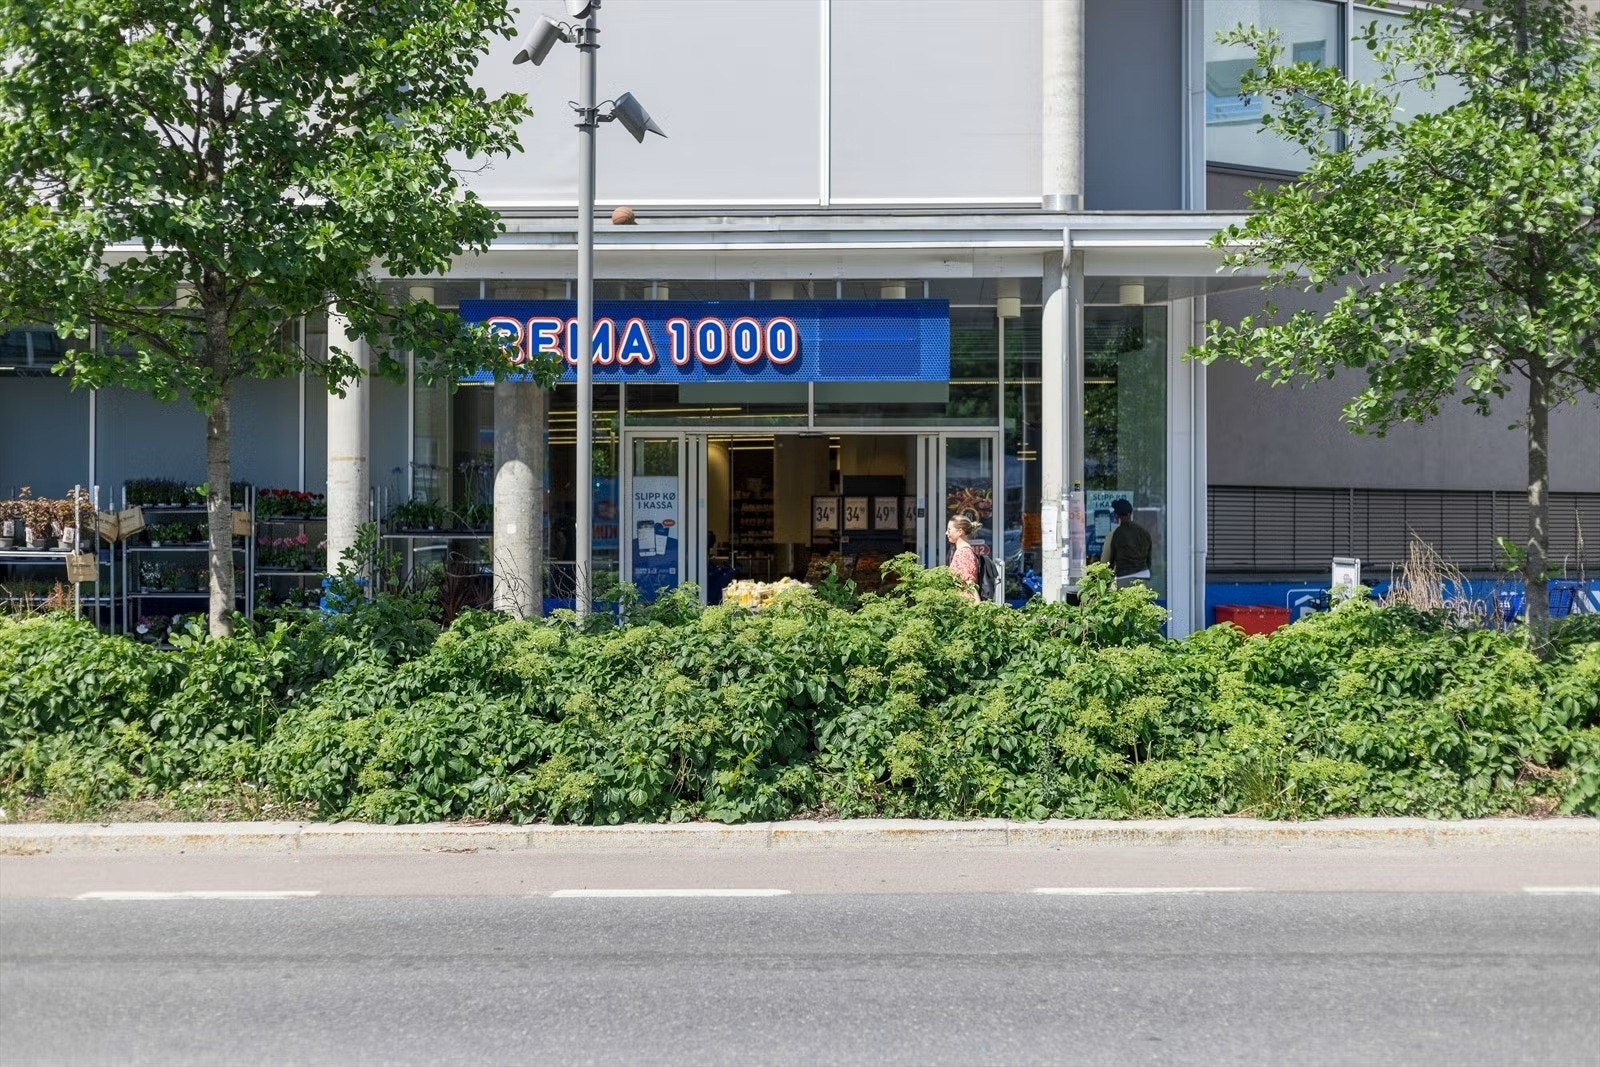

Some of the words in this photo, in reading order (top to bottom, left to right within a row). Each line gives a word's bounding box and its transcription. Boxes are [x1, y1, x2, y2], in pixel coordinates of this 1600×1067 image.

[667, 316, 798, 365] 1000
[635, 492, 660, 501] SLIPP
[662, 492, 676, 501] KØ
[643, 501, 673, 510] KASSA
[816, 506, 829, 522] 34
[846, 506, 859, 522] 34
[876, 506, 889, 522] 49
